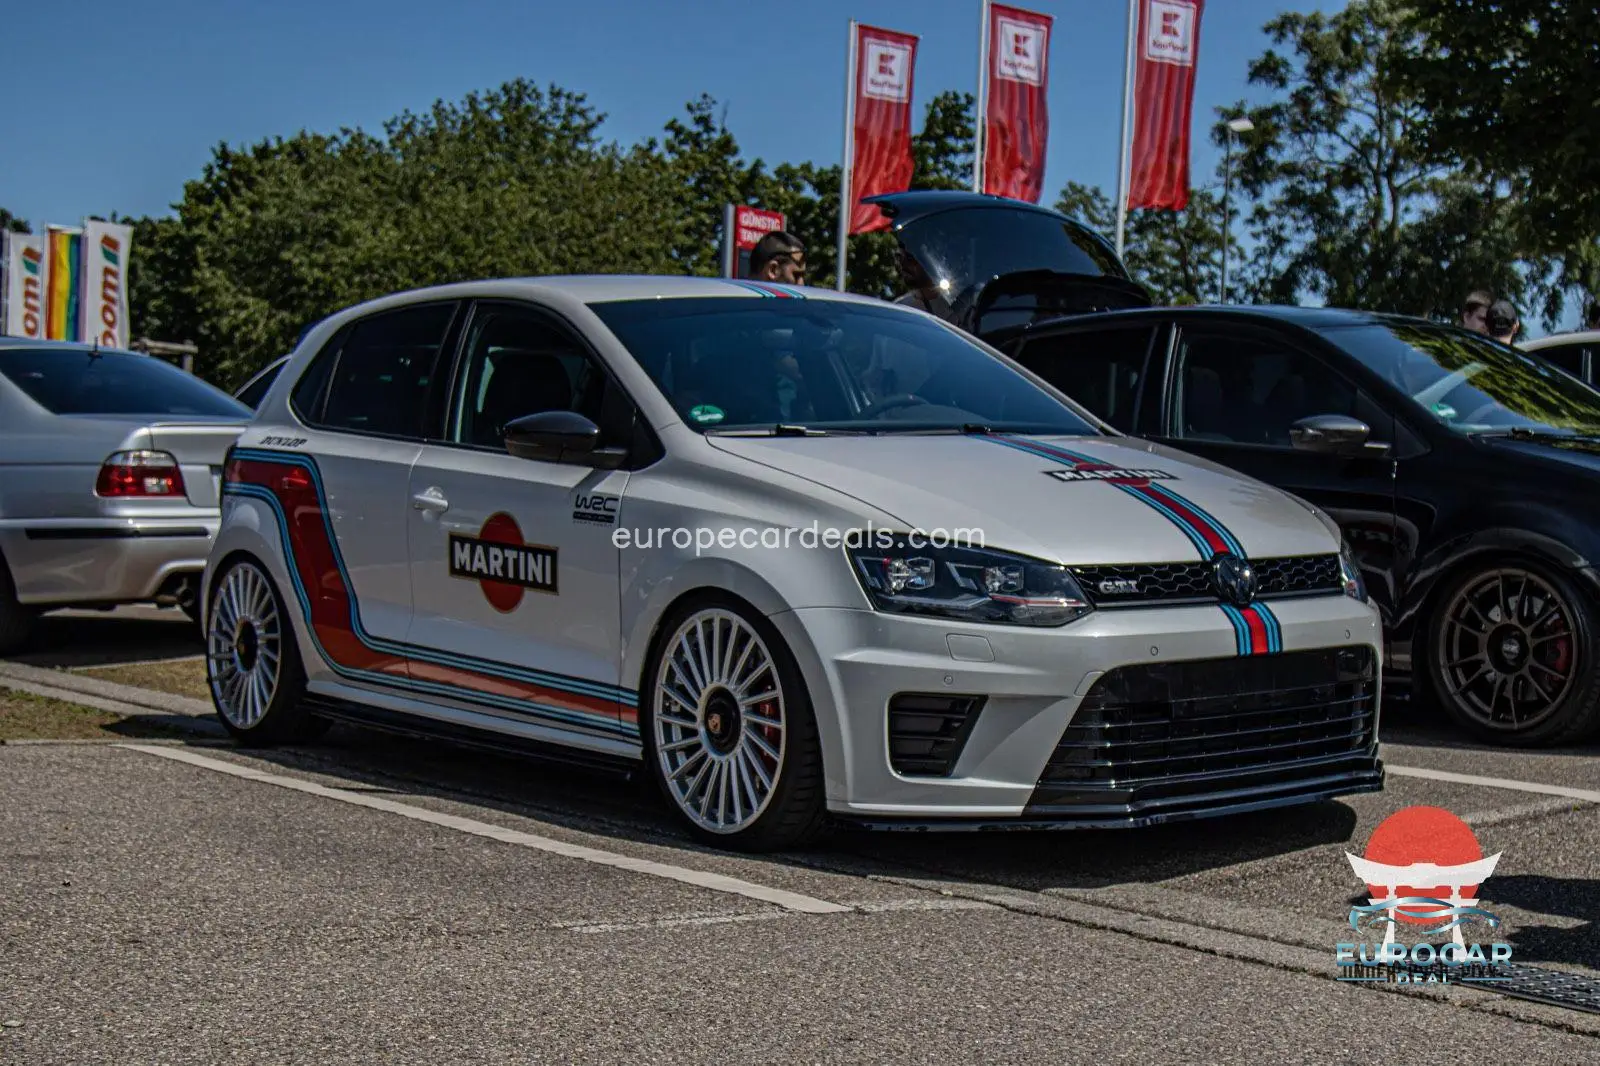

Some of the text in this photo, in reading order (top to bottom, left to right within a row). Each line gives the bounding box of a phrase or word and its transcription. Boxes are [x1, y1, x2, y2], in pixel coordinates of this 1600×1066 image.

[1053, 470, 1171, 480] MARTINI
[575, 494, 619, 512] WRC
[453, 541, 553, 585] MARTINI
[1099, 580, 1139, 594] GTI
